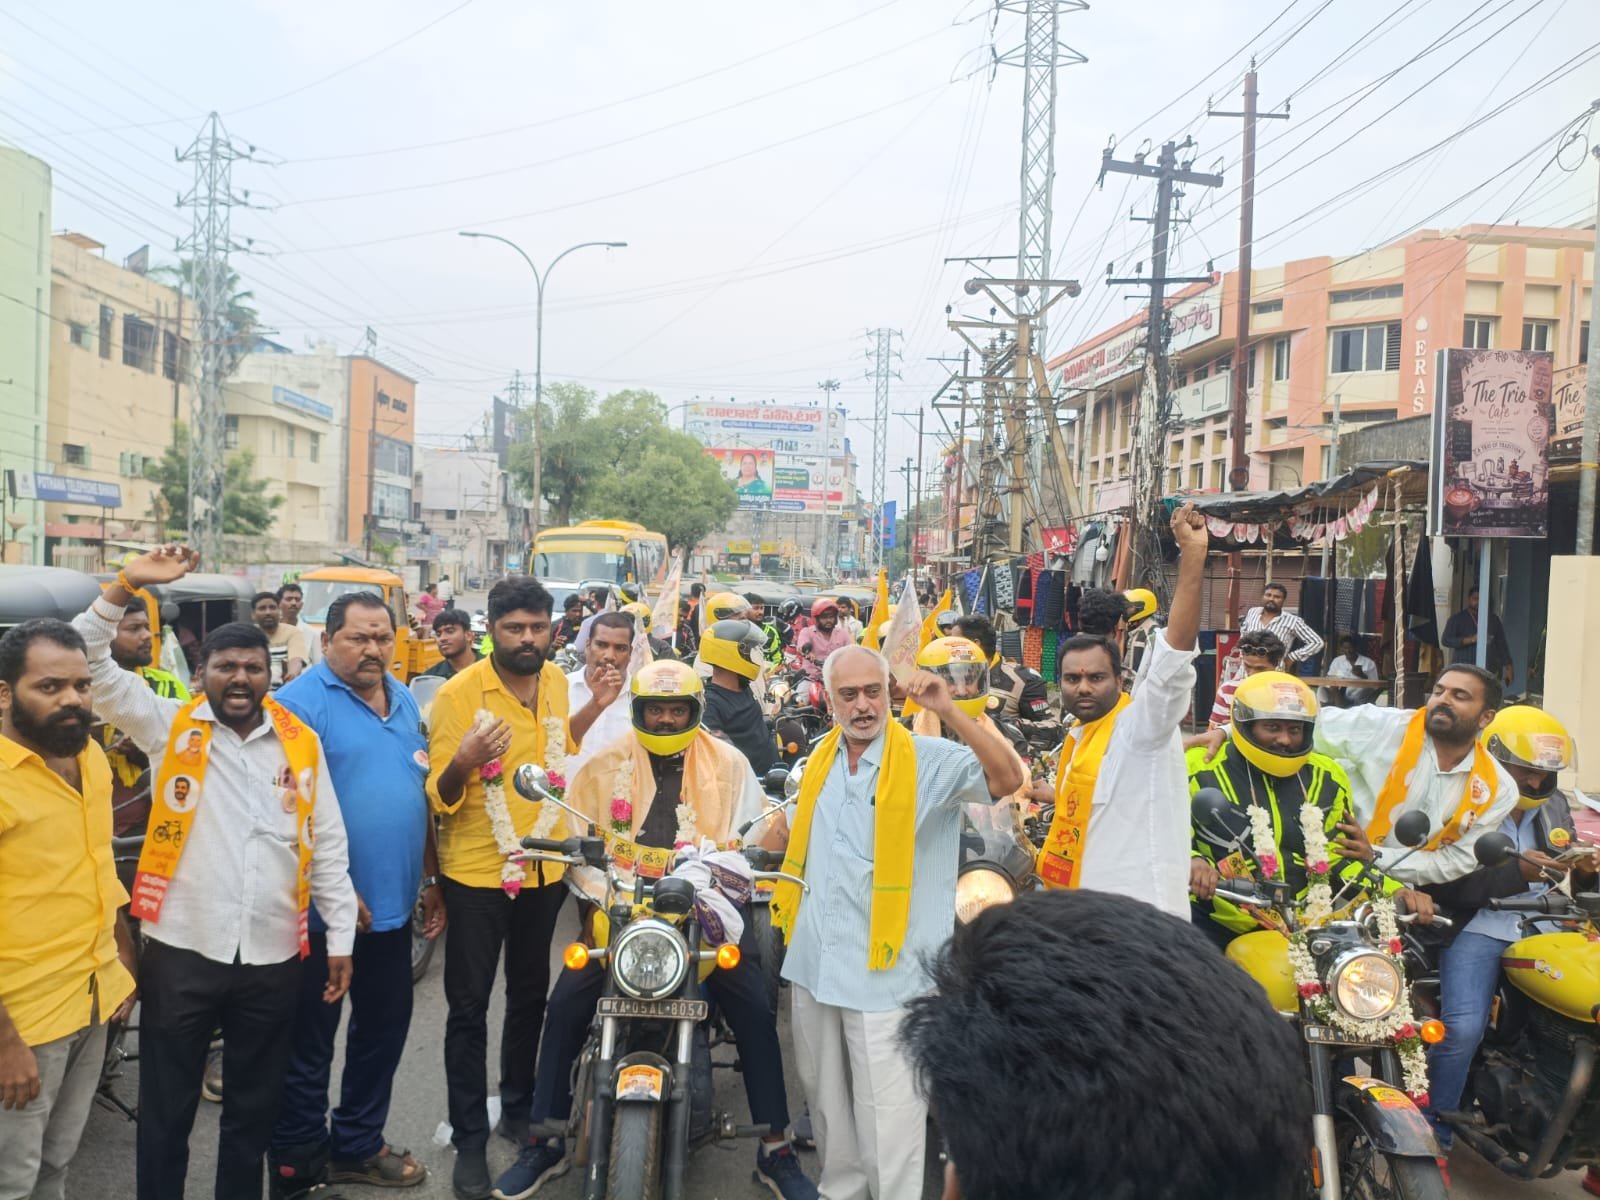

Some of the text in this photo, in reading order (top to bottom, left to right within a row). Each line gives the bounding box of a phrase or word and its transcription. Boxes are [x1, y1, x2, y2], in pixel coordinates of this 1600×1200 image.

[1472, 379, 1527, 408] The Trio
[1555, 383, 1580, 411] The
[1320, 1028, 1335, 1041] KA
